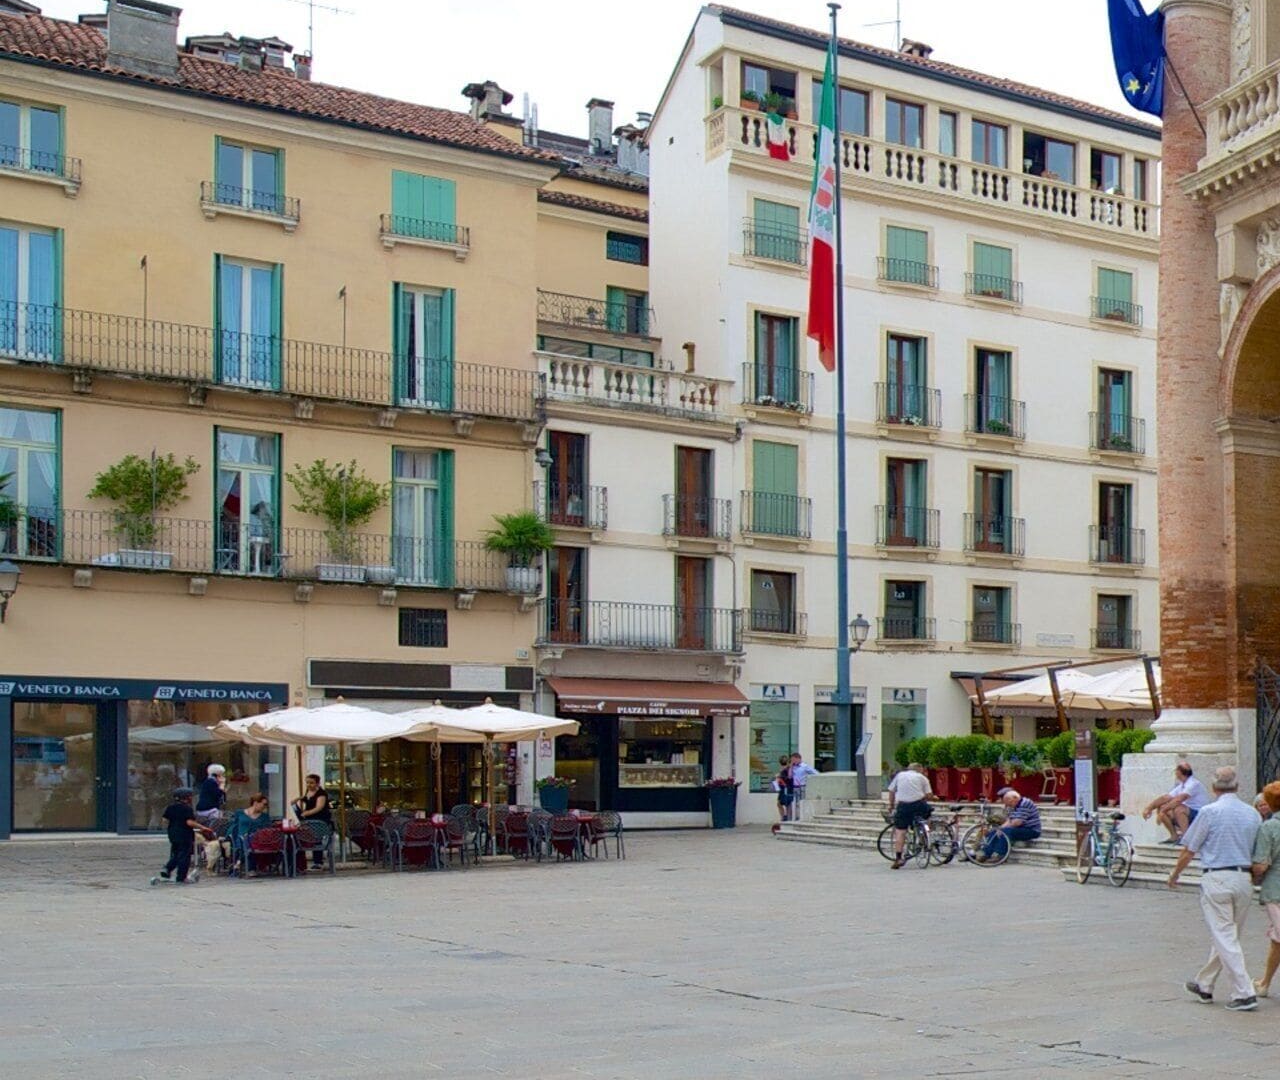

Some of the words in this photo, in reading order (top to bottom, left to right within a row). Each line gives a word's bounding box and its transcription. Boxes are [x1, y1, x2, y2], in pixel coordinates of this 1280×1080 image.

[18, 684, 71, 694] VENETO
[74, 686, 120, 695] BANCA
[178, 688, 227, 698] VENETO
[230, 690, 272, 699] BANCA
[617, 706, 647, 714] PIAZZA
[649, 707, 663, 715] DEI
